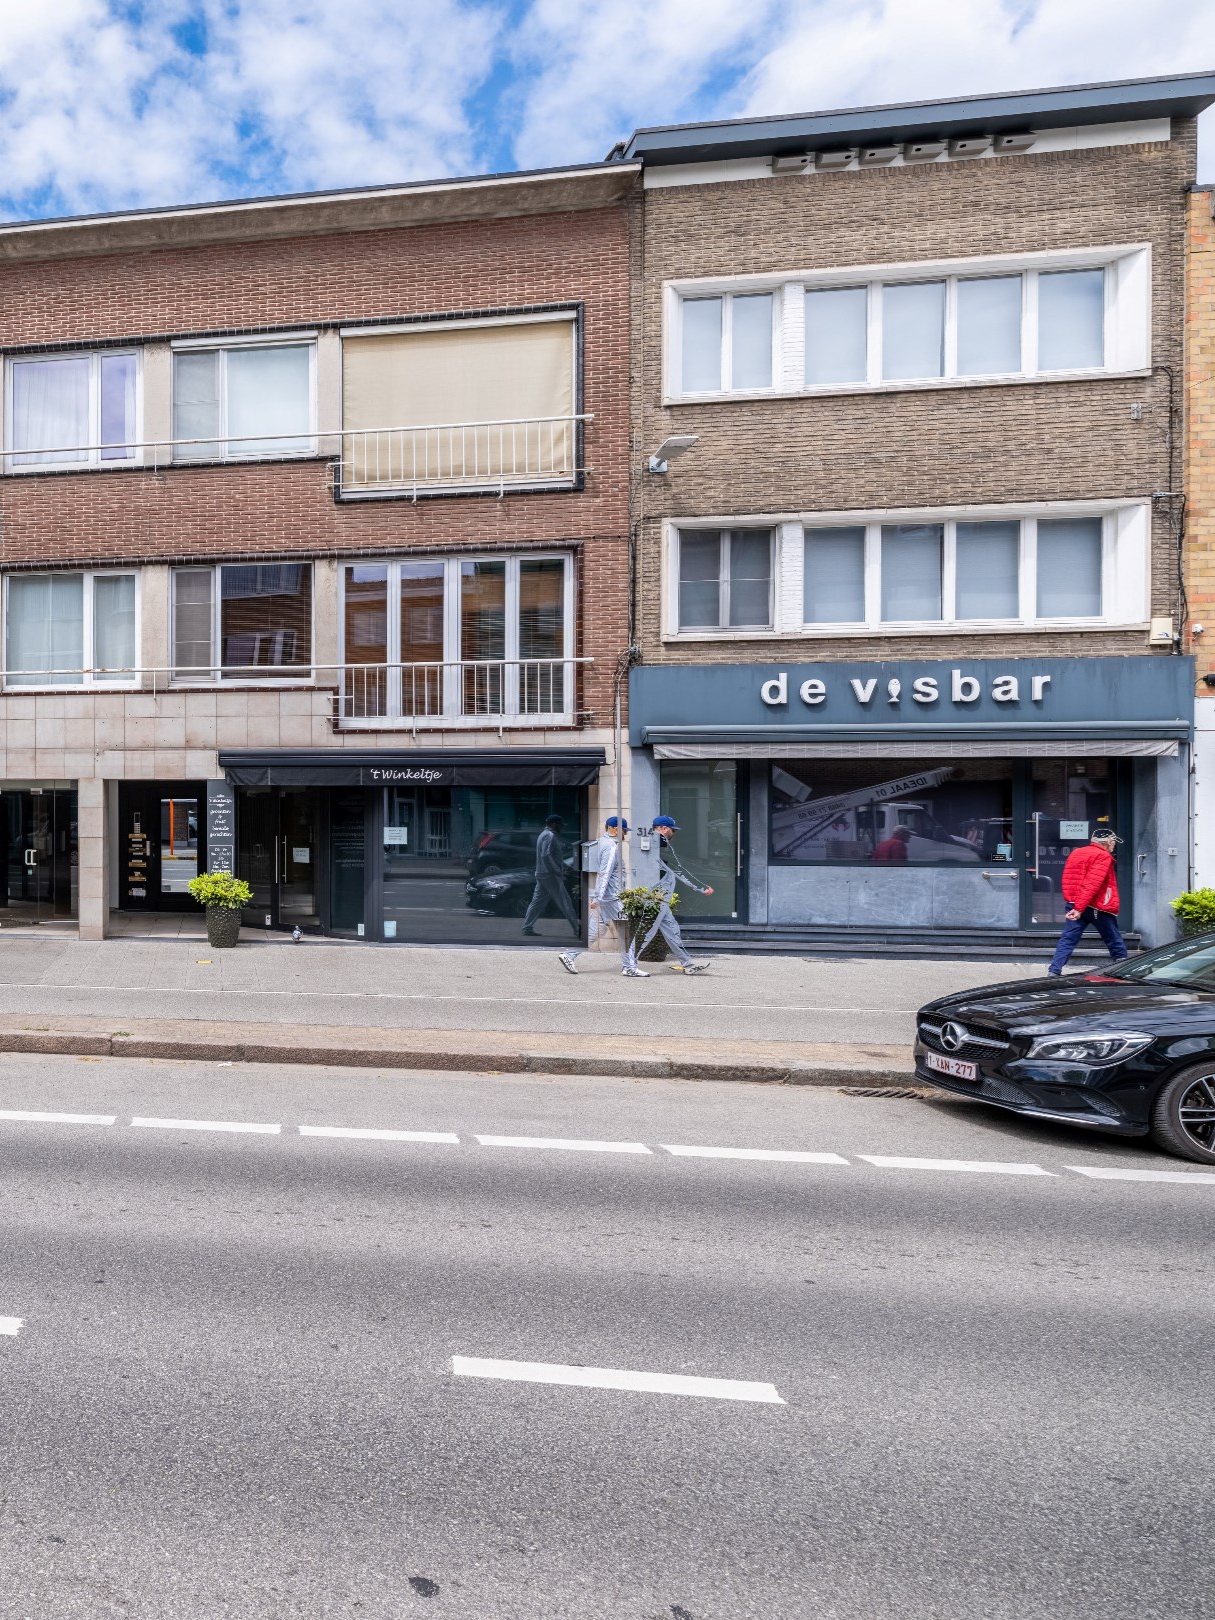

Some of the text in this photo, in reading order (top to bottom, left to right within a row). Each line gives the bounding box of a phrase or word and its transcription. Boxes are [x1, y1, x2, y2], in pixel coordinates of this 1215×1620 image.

[760, 669, 1052, 705] de visbar
[381, 768, 443, 782] Winkeltje
[637, 827, 654, 837] 314
